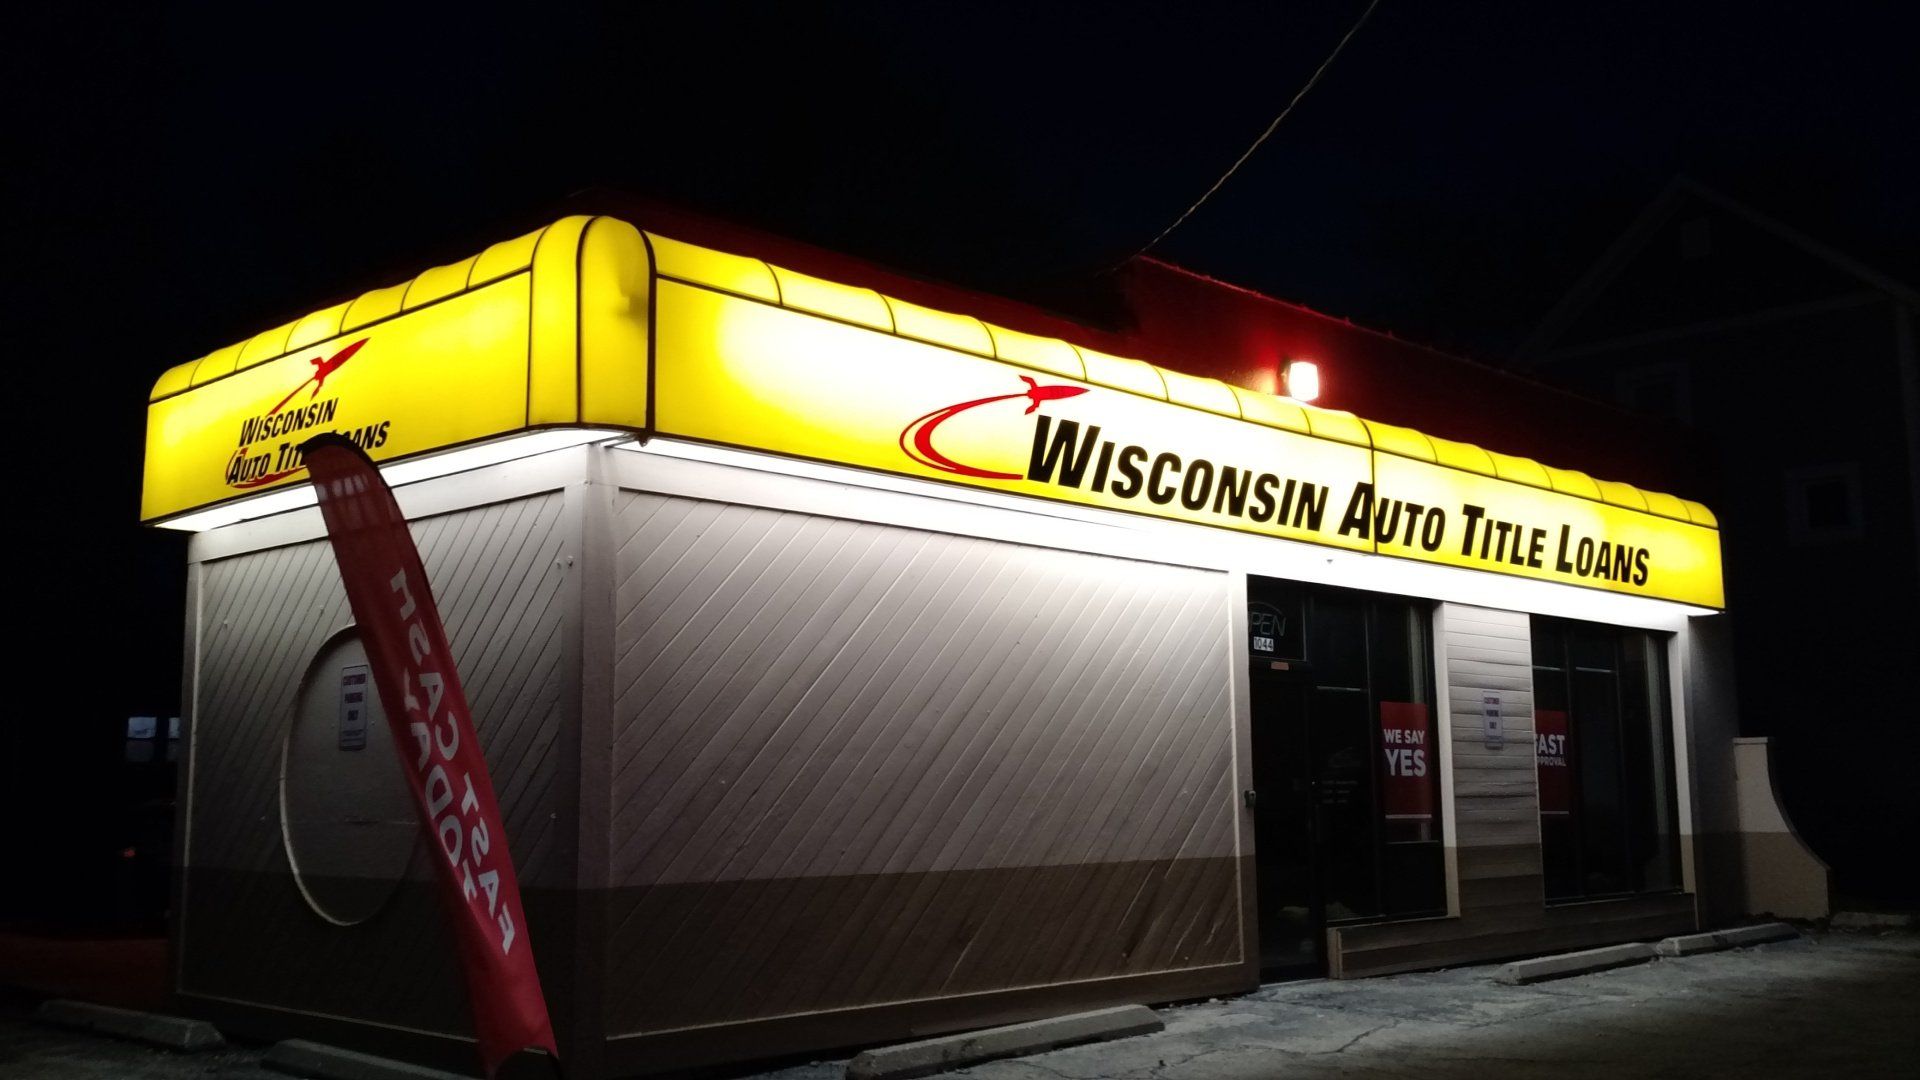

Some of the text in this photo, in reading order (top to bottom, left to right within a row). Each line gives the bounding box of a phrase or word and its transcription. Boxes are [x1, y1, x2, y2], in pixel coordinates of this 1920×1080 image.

[239, 397, 339, 447] WISCONSIN
[226, 453, 271, 485] AUTO
[275, 442, 305, 472] TIT
[1028, 414, 1650, 587] WISCONSIN AUTO TITLE LOANS
[1248, 611, 1287, 637] PEN
[1384, 729, 1425, 745] WE SAY
[1384, 748, 1427, 778] YES
